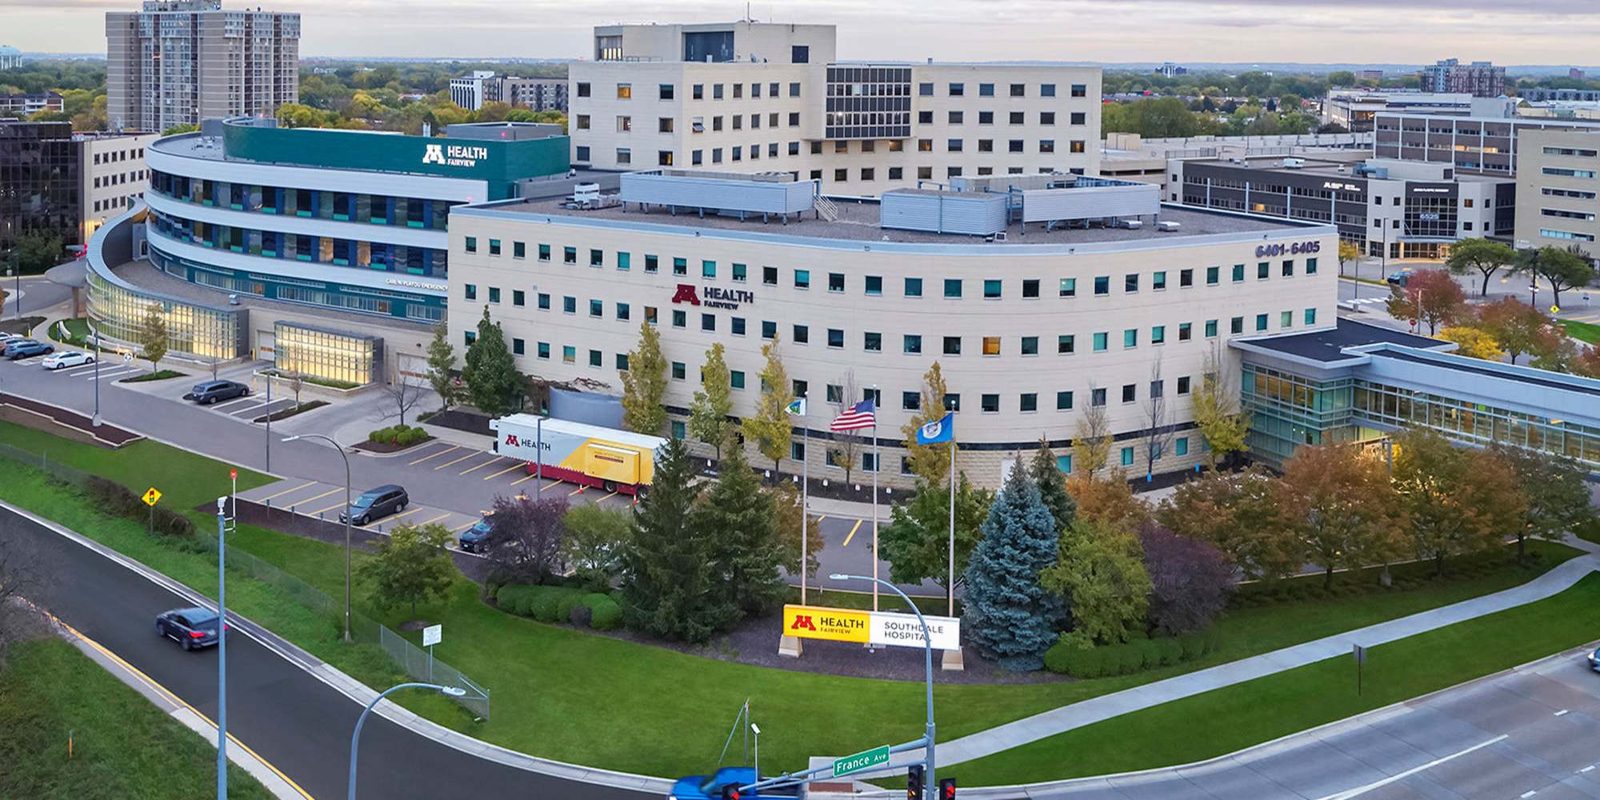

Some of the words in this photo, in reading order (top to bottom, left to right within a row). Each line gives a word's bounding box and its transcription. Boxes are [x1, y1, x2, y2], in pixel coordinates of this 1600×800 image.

[447, 145, 487, 160] HEALTH
[447, 159, 476, 167] FAIRVIEW
[703, 286, 754, 304] HEALTH
[703, 300, 739, 310] FAIRVIEW
[521, 438, 551, 451] HEATH
[820, 616, 864, 629] HEALTH
[884, 630, 929, 641] HOSPITA
[836, 757, 870, 772] France
[873, 753, 887, 762] Ave
